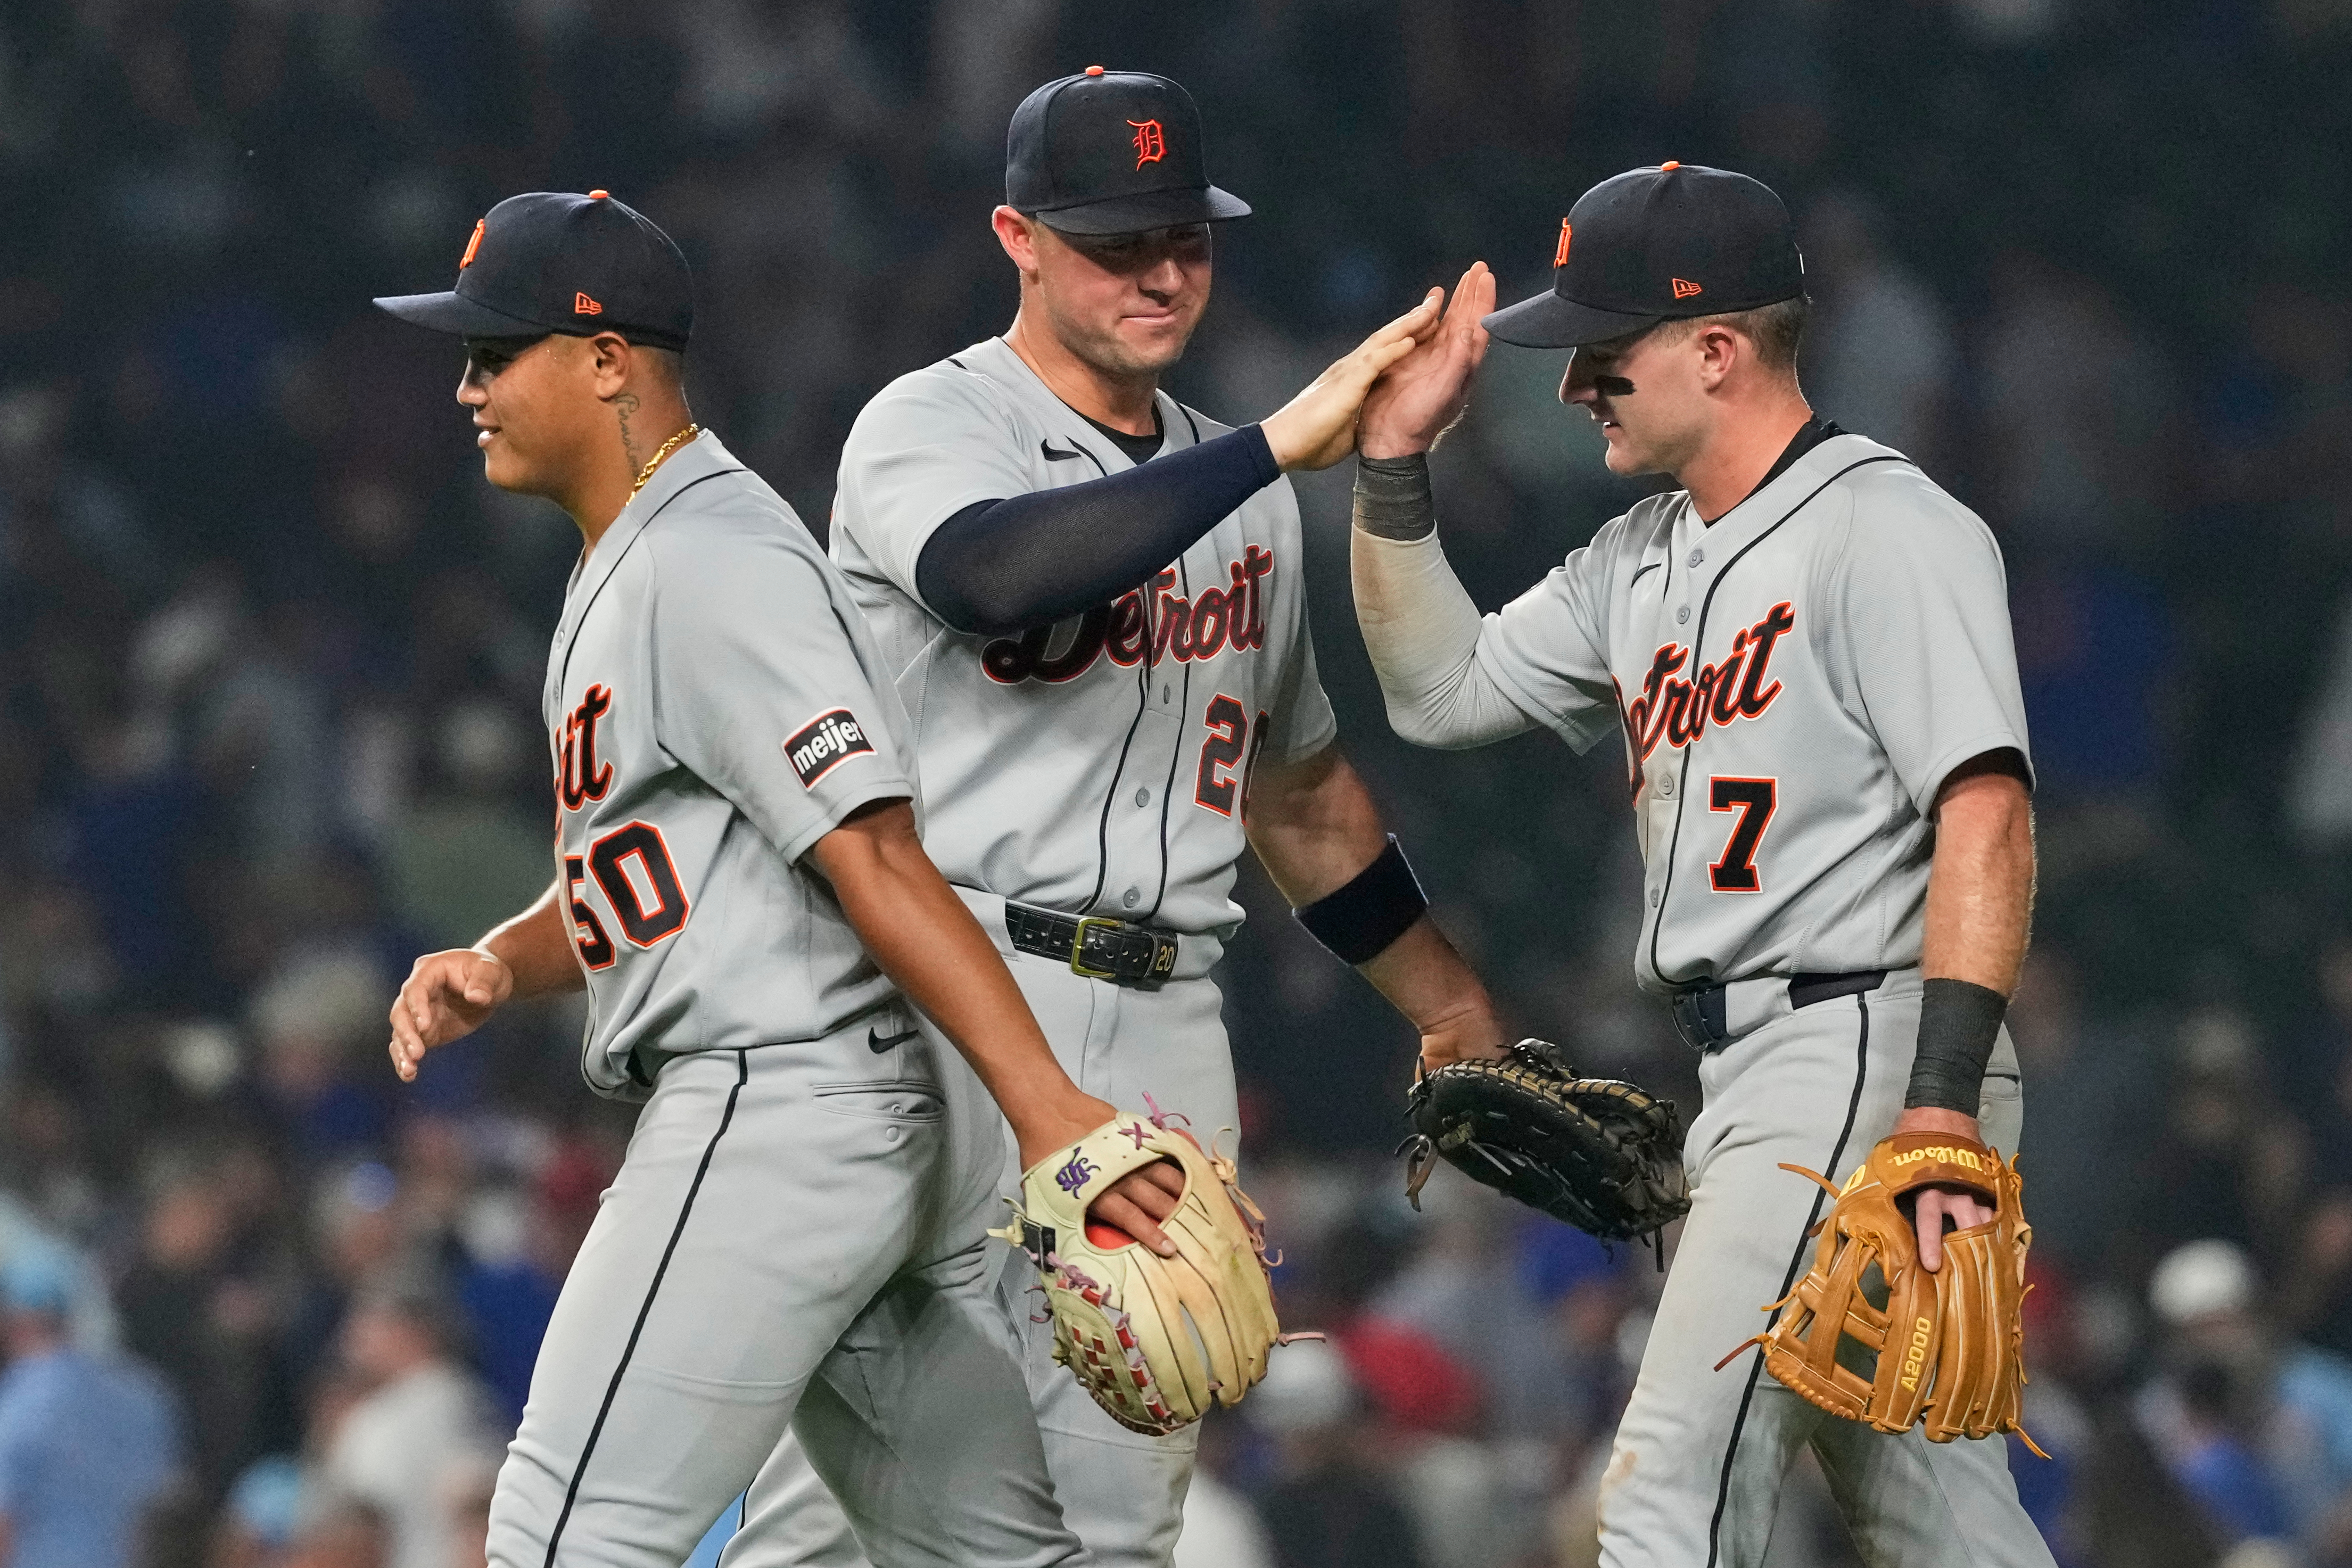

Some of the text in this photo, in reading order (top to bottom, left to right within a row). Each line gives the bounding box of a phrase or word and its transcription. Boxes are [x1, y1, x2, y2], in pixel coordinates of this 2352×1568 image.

[1126, 119, 1168, 171] D
[1610, 599, 1796, 807] etroit
[793, 718, 863, 775] meijer
[1707, 774, 1779, 894] 7
[563, 819, 691, 973] 50
[1156, 945, 1175, 972] 20
[1893, 1145, 1983, 1171] Wilson
[1901, 1317, 1932, 1393] A2000
